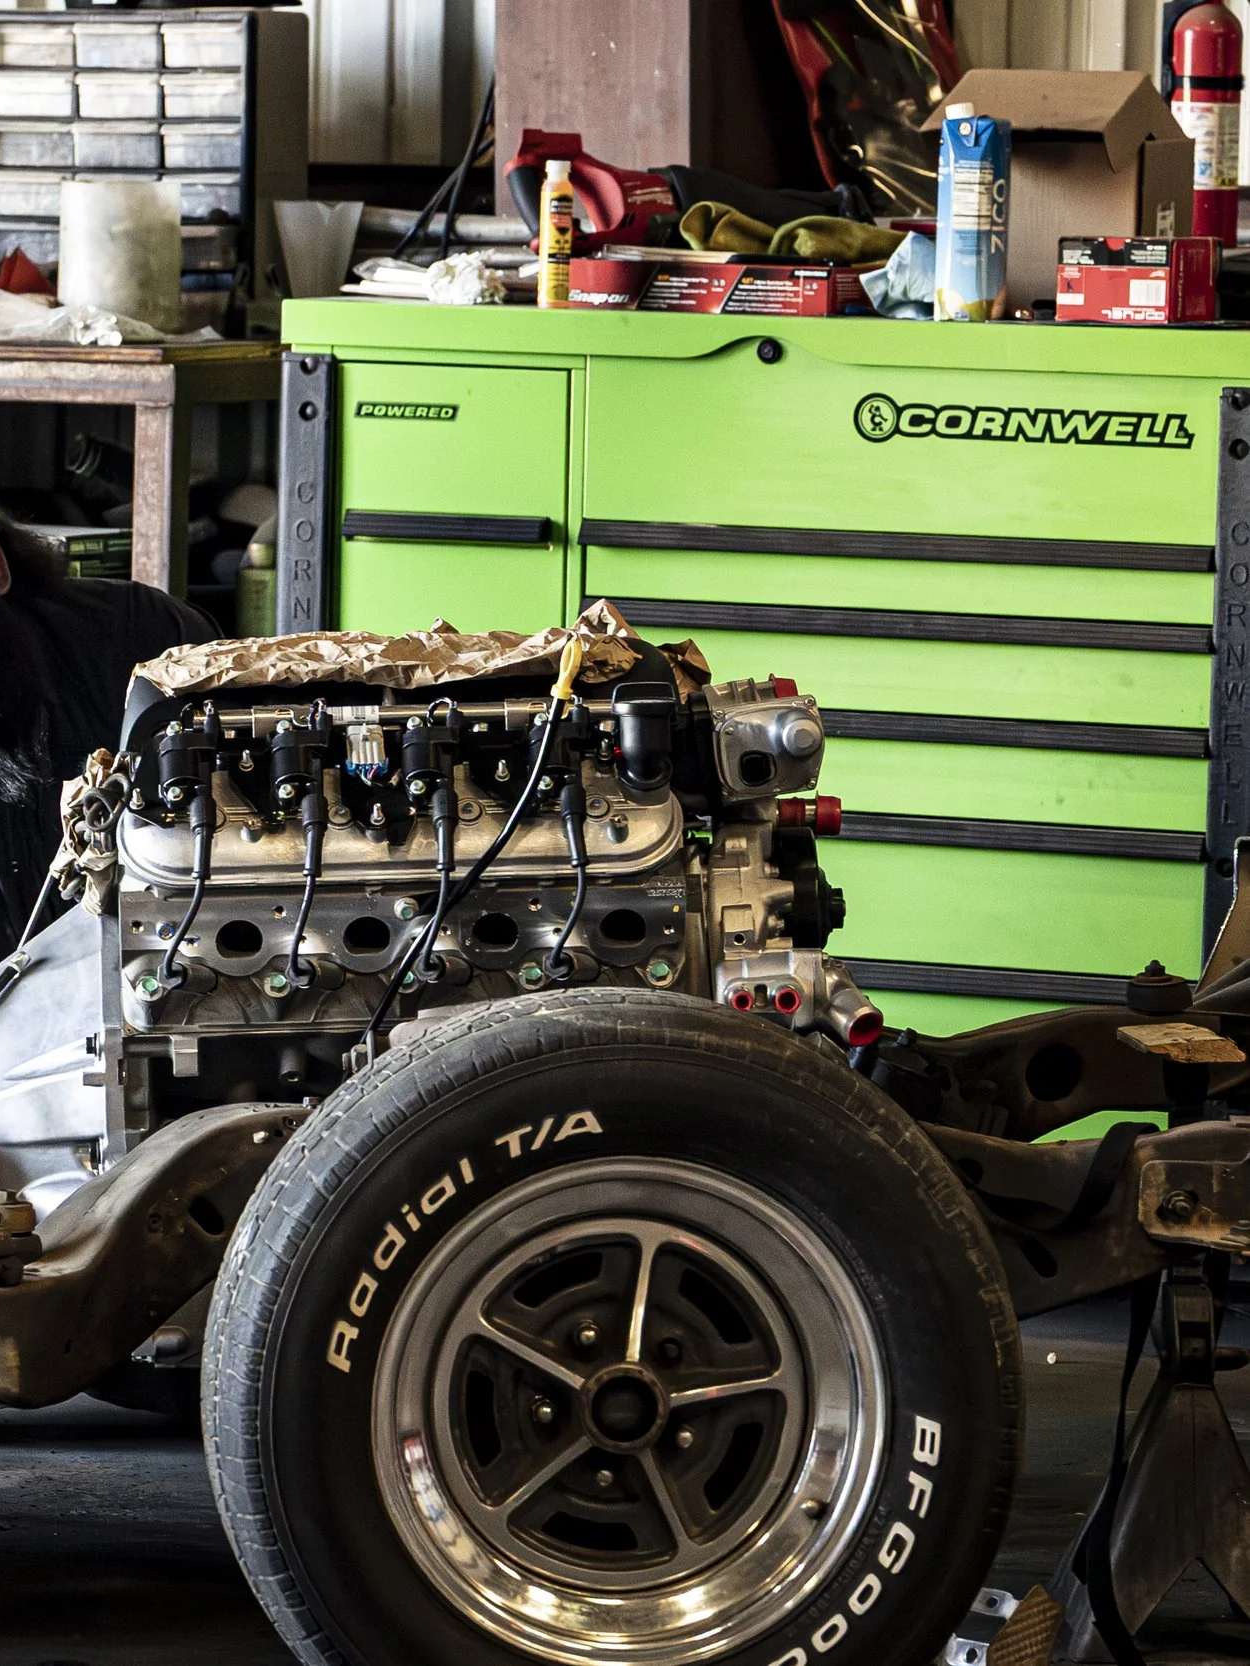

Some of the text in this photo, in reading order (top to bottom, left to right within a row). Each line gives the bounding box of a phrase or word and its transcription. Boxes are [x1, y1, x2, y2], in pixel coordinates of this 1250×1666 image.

[991, 178, 1007, 255] ZICO
[360, 404, 454, 418] POWERED
[897, 403, 1193, 447] CORNWELL
[1221, 522, 1249, 825] CORNWELL
[326, 1109, 605, 1374] Radial T/A
